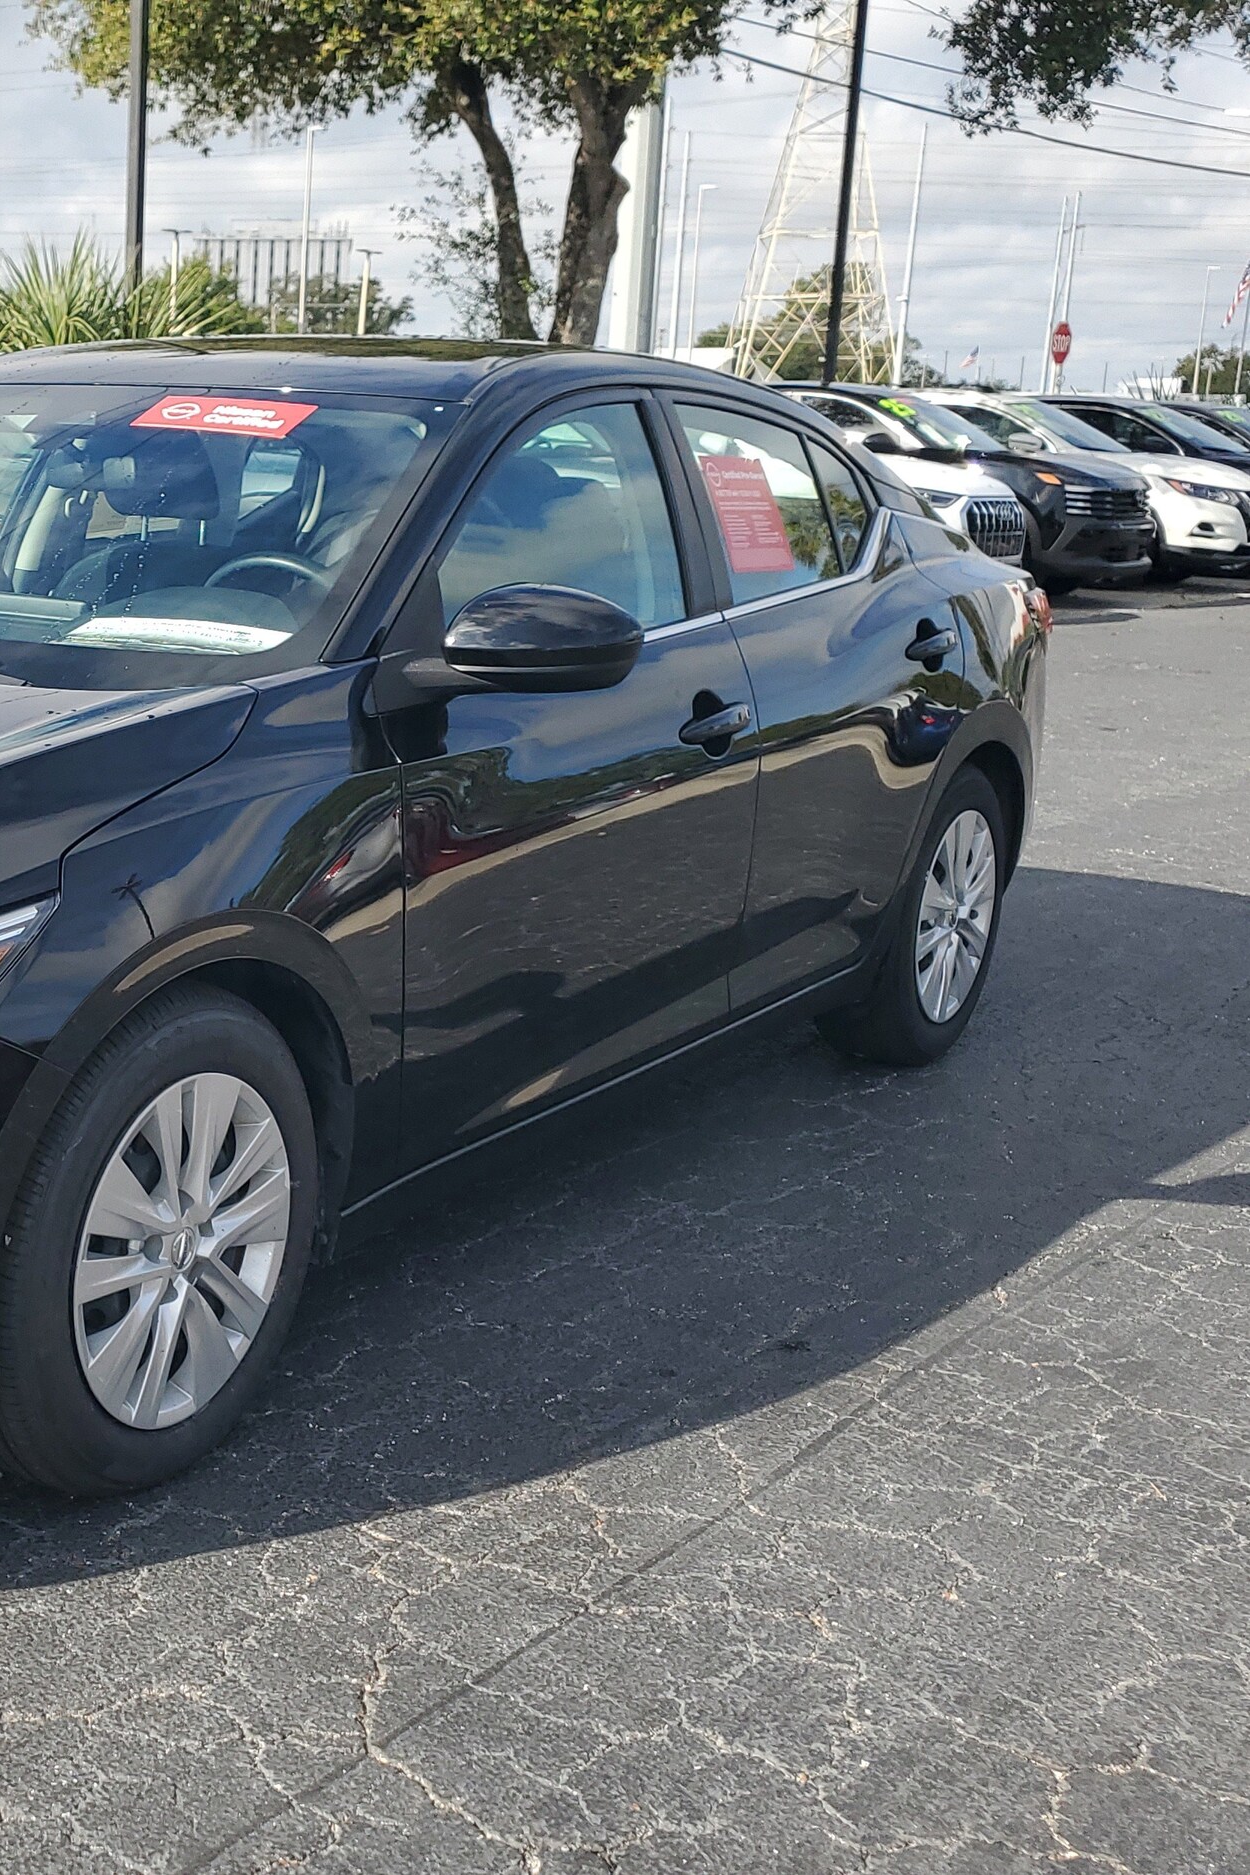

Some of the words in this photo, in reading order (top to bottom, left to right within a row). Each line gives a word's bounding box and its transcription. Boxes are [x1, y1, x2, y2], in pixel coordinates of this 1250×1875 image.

[1053, 334, 1070, 351] STOP
[212, 405, 277, 419] Nissan
[203, 413, 285, 430] Certified
